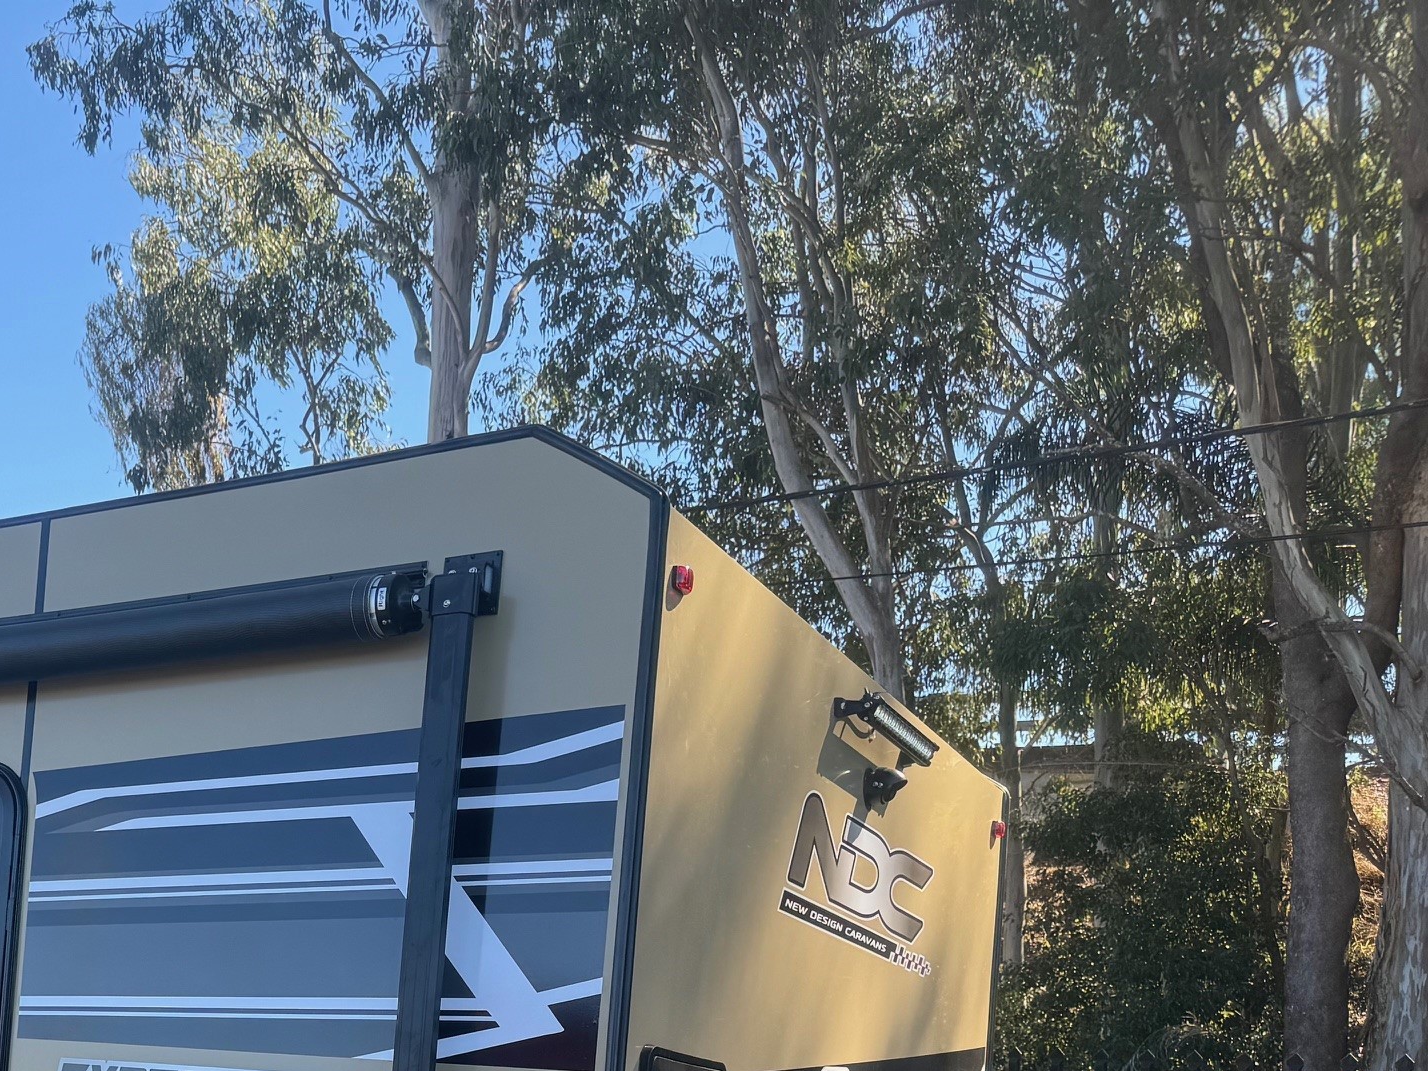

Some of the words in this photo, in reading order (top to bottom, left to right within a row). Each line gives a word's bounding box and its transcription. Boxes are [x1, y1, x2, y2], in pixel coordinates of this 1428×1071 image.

[786, 790, 934, 944] NDC
[785, 899, 809, 915] NEW
[810, 910, 843, 931] DESIGN
[845, 927, 887, 953] CARAVANS
